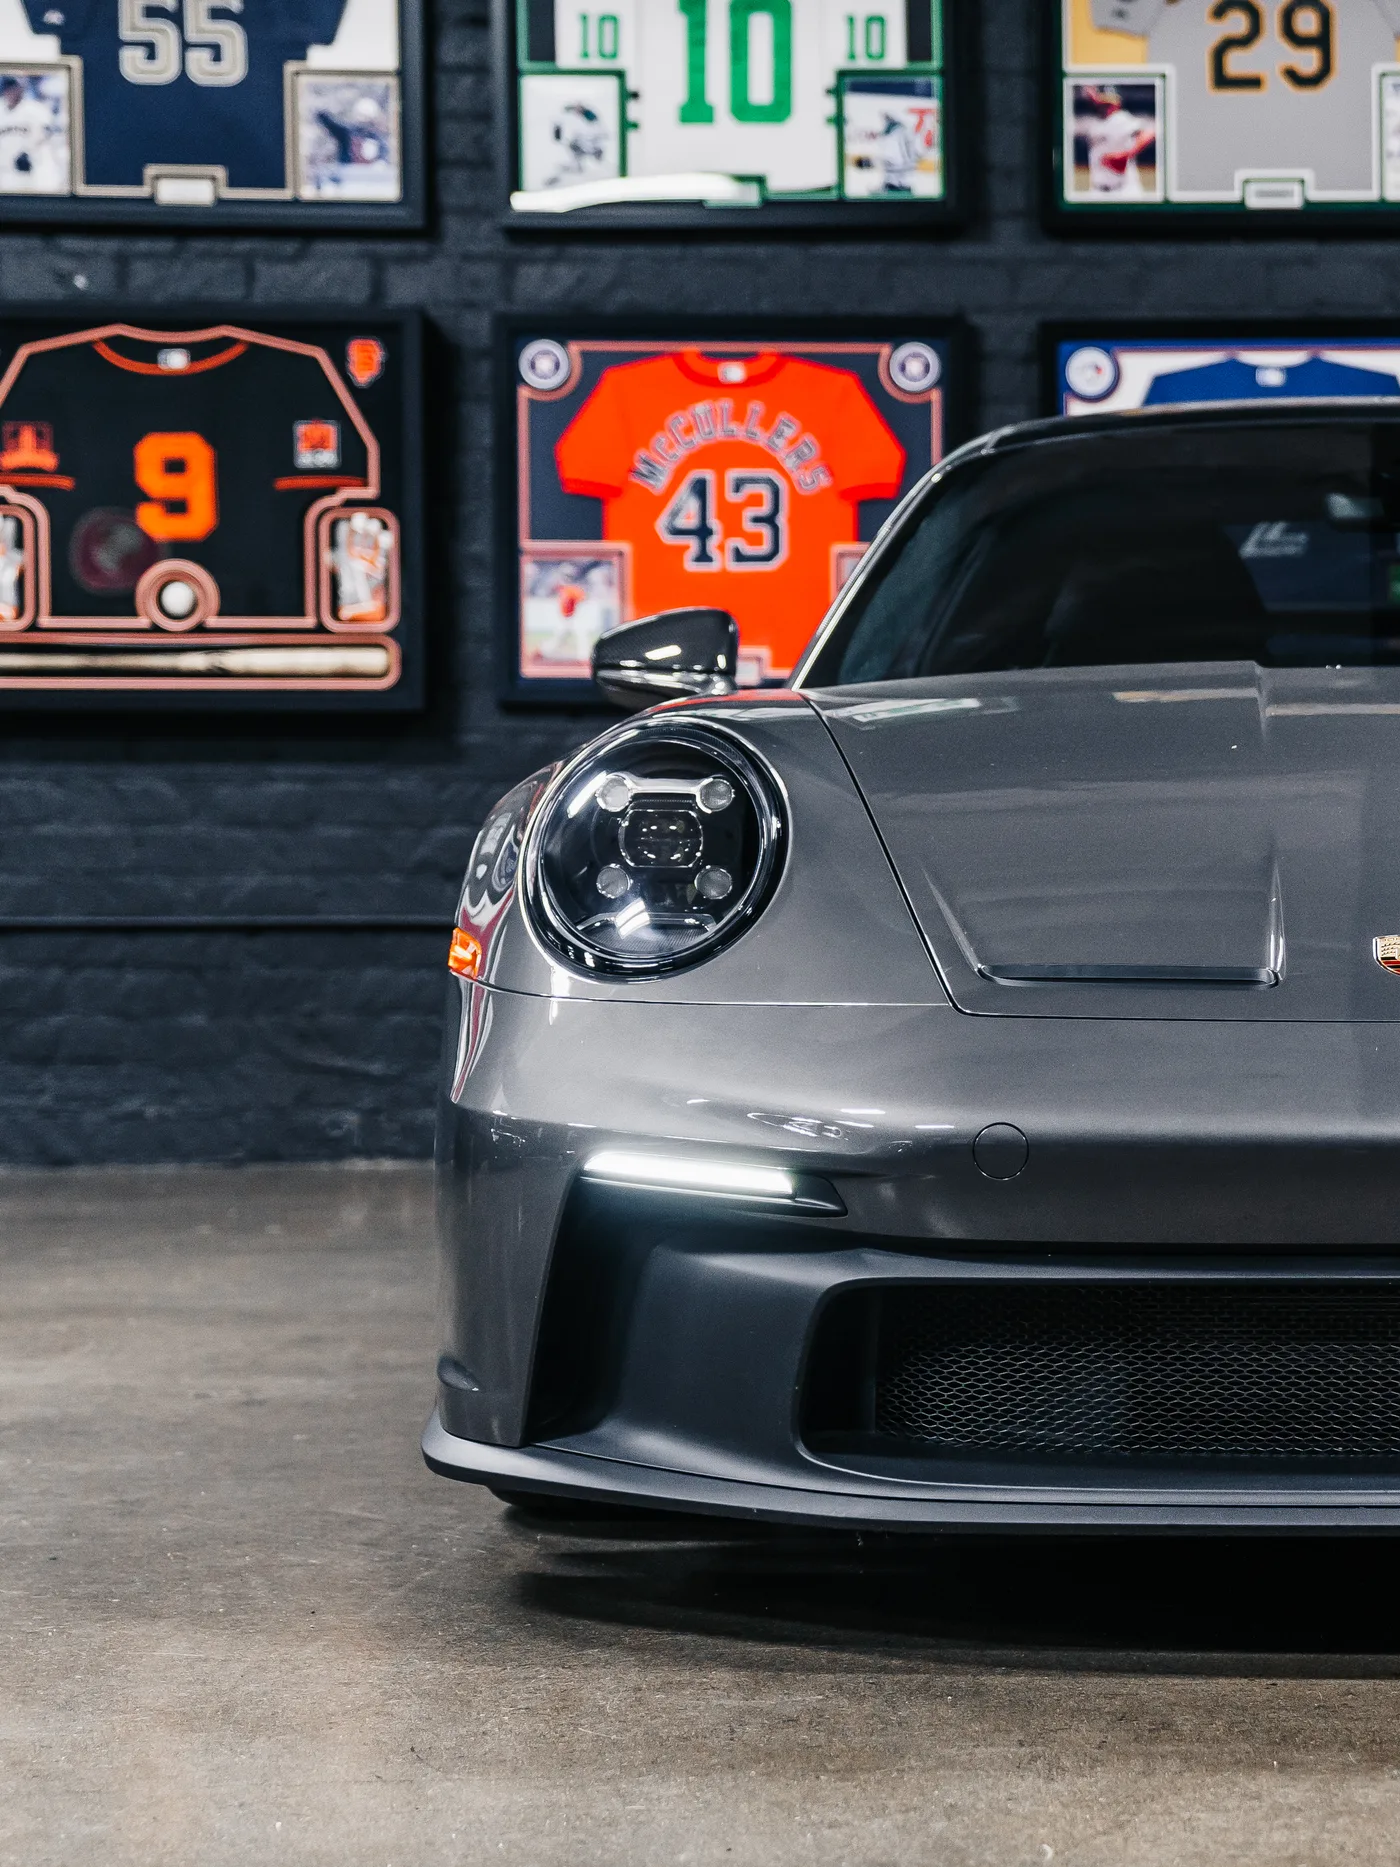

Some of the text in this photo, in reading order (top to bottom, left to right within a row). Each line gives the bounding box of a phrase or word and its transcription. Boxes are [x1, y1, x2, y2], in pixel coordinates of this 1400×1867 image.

[118, 0, 249, 87] 55
[577, 13, 620, 60] 10
[678, 0, 793, 125] 10
[845, 14, 887, 62] 10
[1206, 0, 1338, 94] 29
[133, 431, 219, 542] 9
[655, 468, 789, 571] 43
